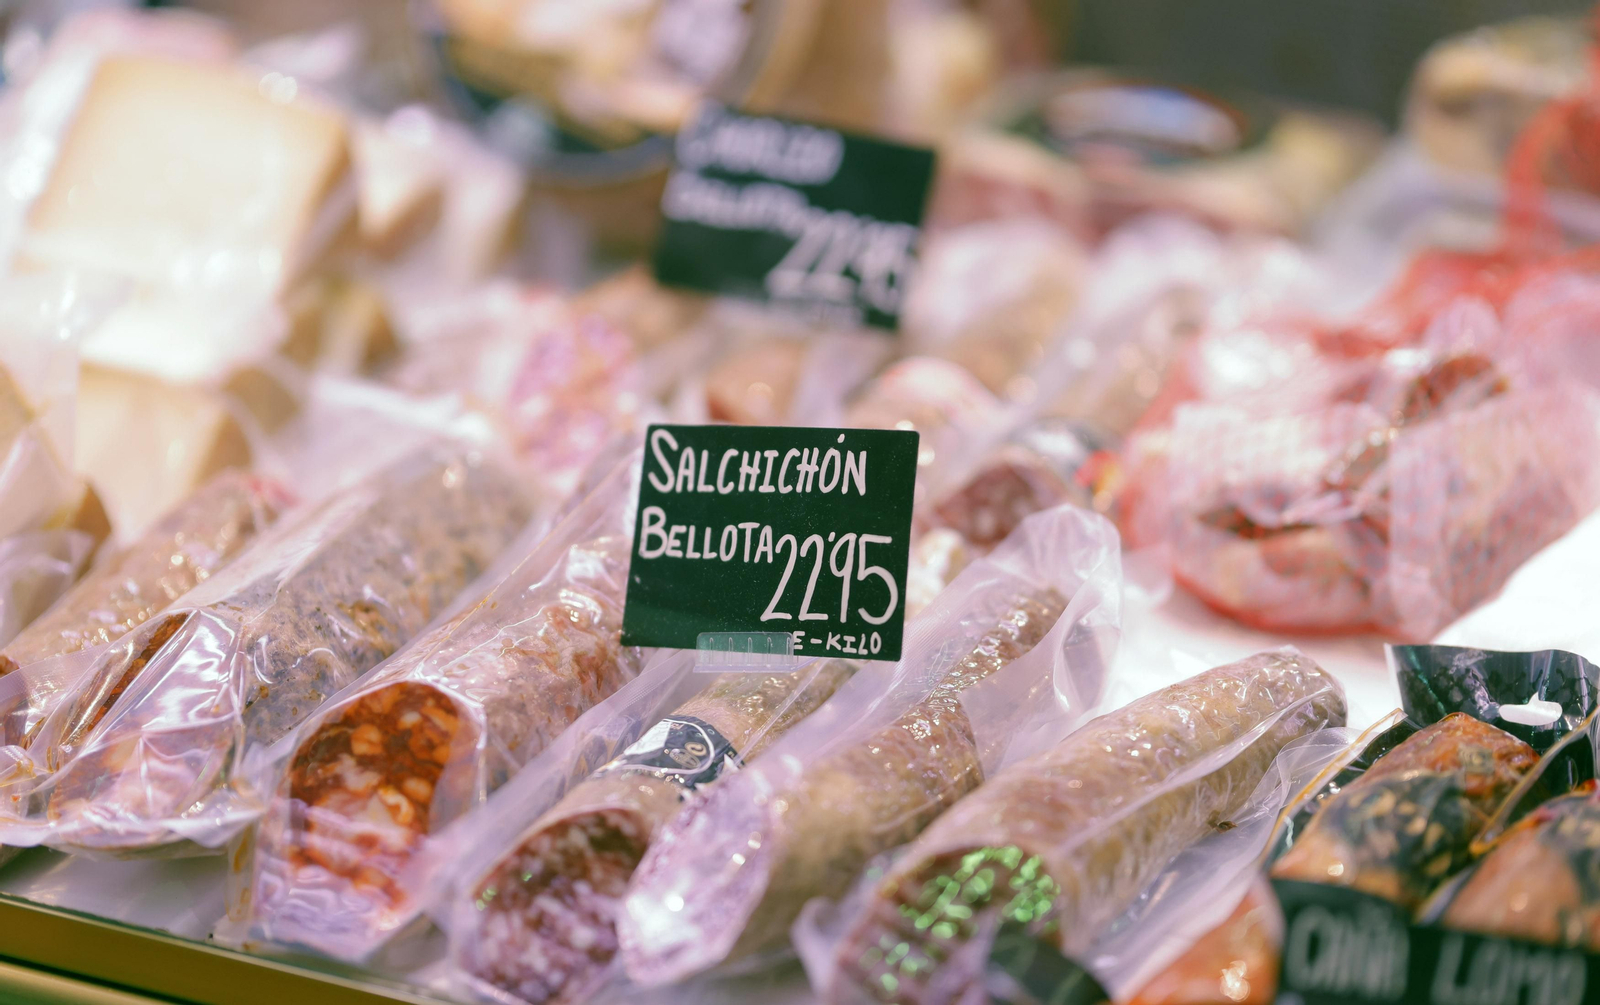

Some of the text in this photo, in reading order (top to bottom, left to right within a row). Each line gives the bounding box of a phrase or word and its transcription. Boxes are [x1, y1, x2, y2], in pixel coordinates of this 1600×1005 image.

[648, 428, 868, 496] SALCHICHÓN
[638, 506, 773, 563] BELLOTA
[760, 531, 899, 625] 22'95
